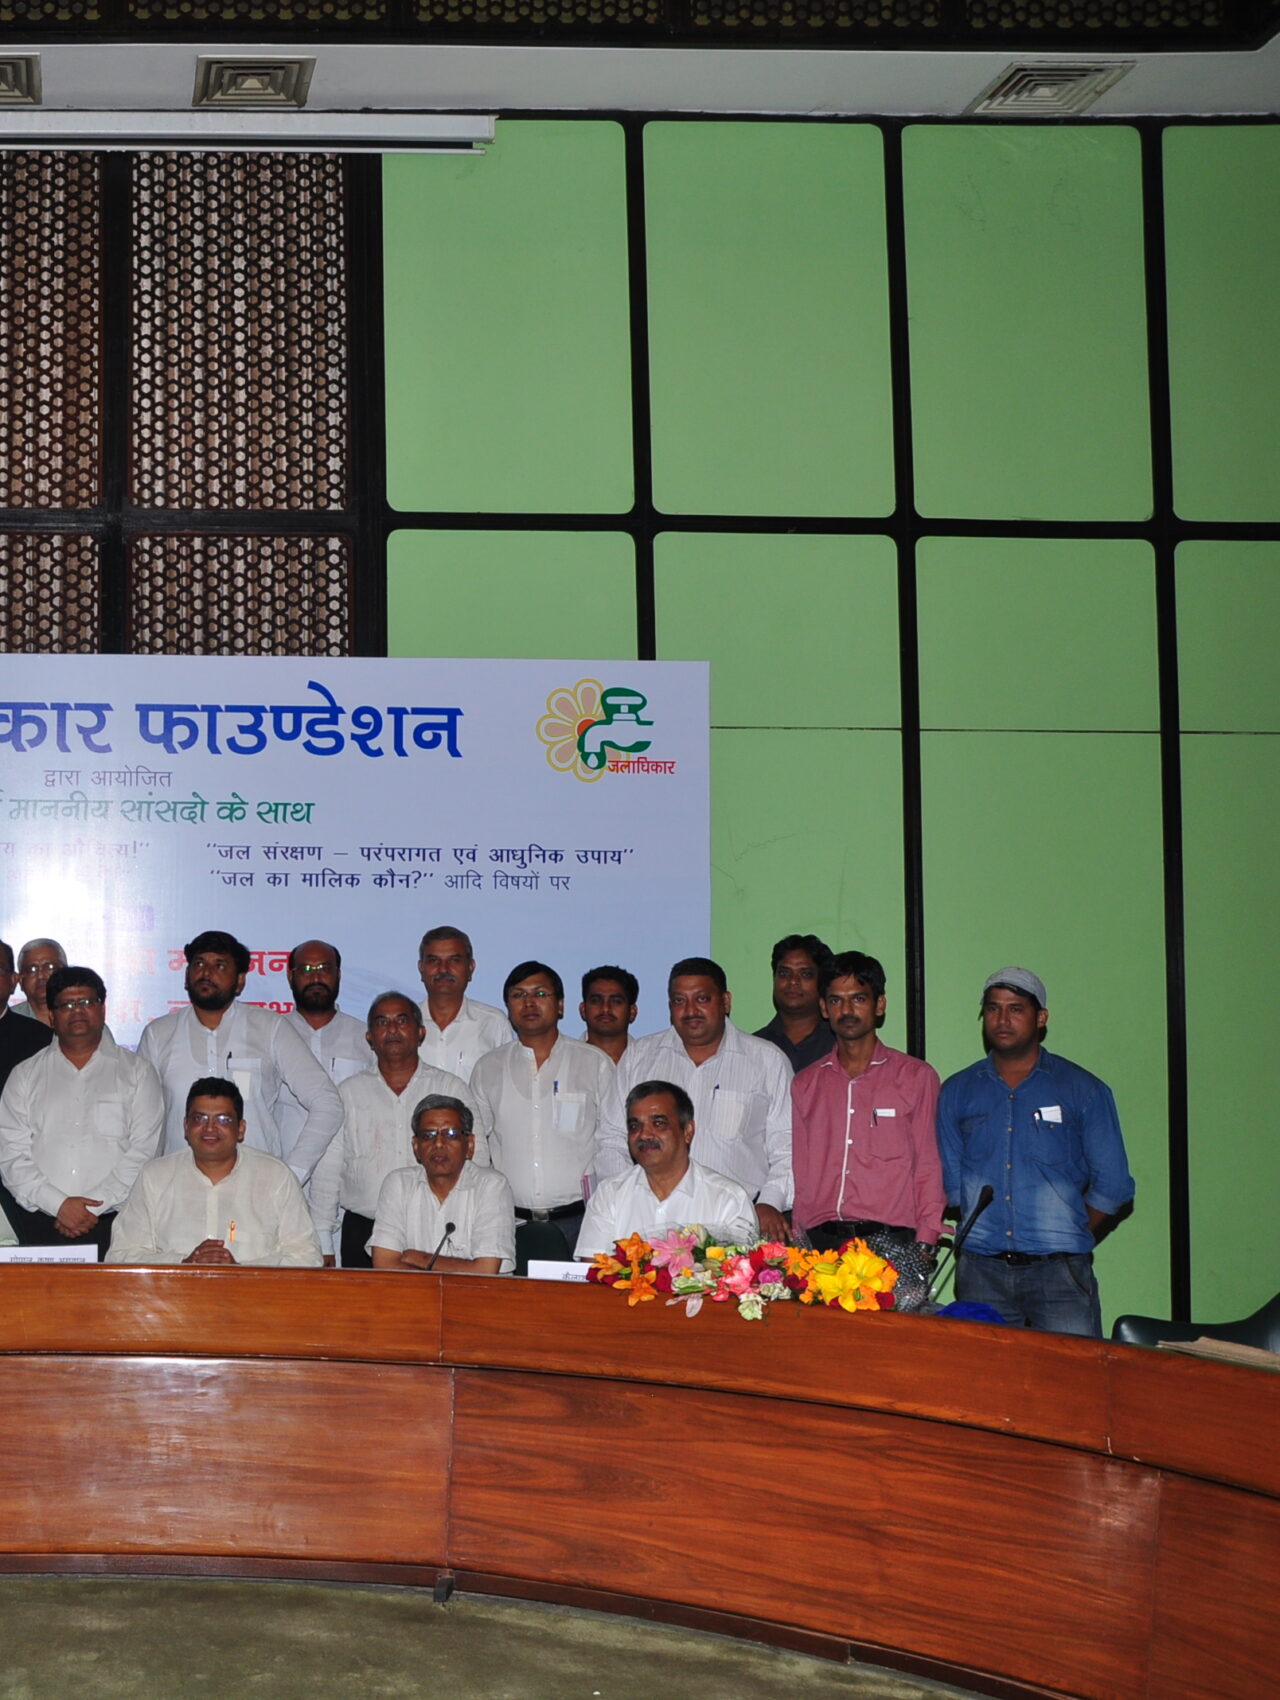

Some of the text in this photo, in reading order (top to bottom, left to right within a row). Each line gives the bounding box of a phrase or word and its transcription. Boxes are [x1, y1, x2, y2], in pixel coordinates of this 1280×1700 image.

[135, 680, 464, 759] फाउण्डेशन
[43, 764, 173, 788] द्वारा आयोजित
[607, 756, 677, 775] जलाधिकार
[8, 790, 113, 822] माननीय
[215, 792, 250, 824] के
[255, 800, 316, 825] साथ
[262, 842, 323, 862] संरक्षण
[360, 842, 442, 863] परंपरागत
[452, 843, 478, 865] एवं
[489, 843, 565, 869] आधुनिक
[265, 872, 290, 888] का
[300, 867, 361, 889] मालिक
[444, 868, 483, 891] आदि
[493, 866, 540, 891] विषयों
[549, 875, 571, 891] पर
